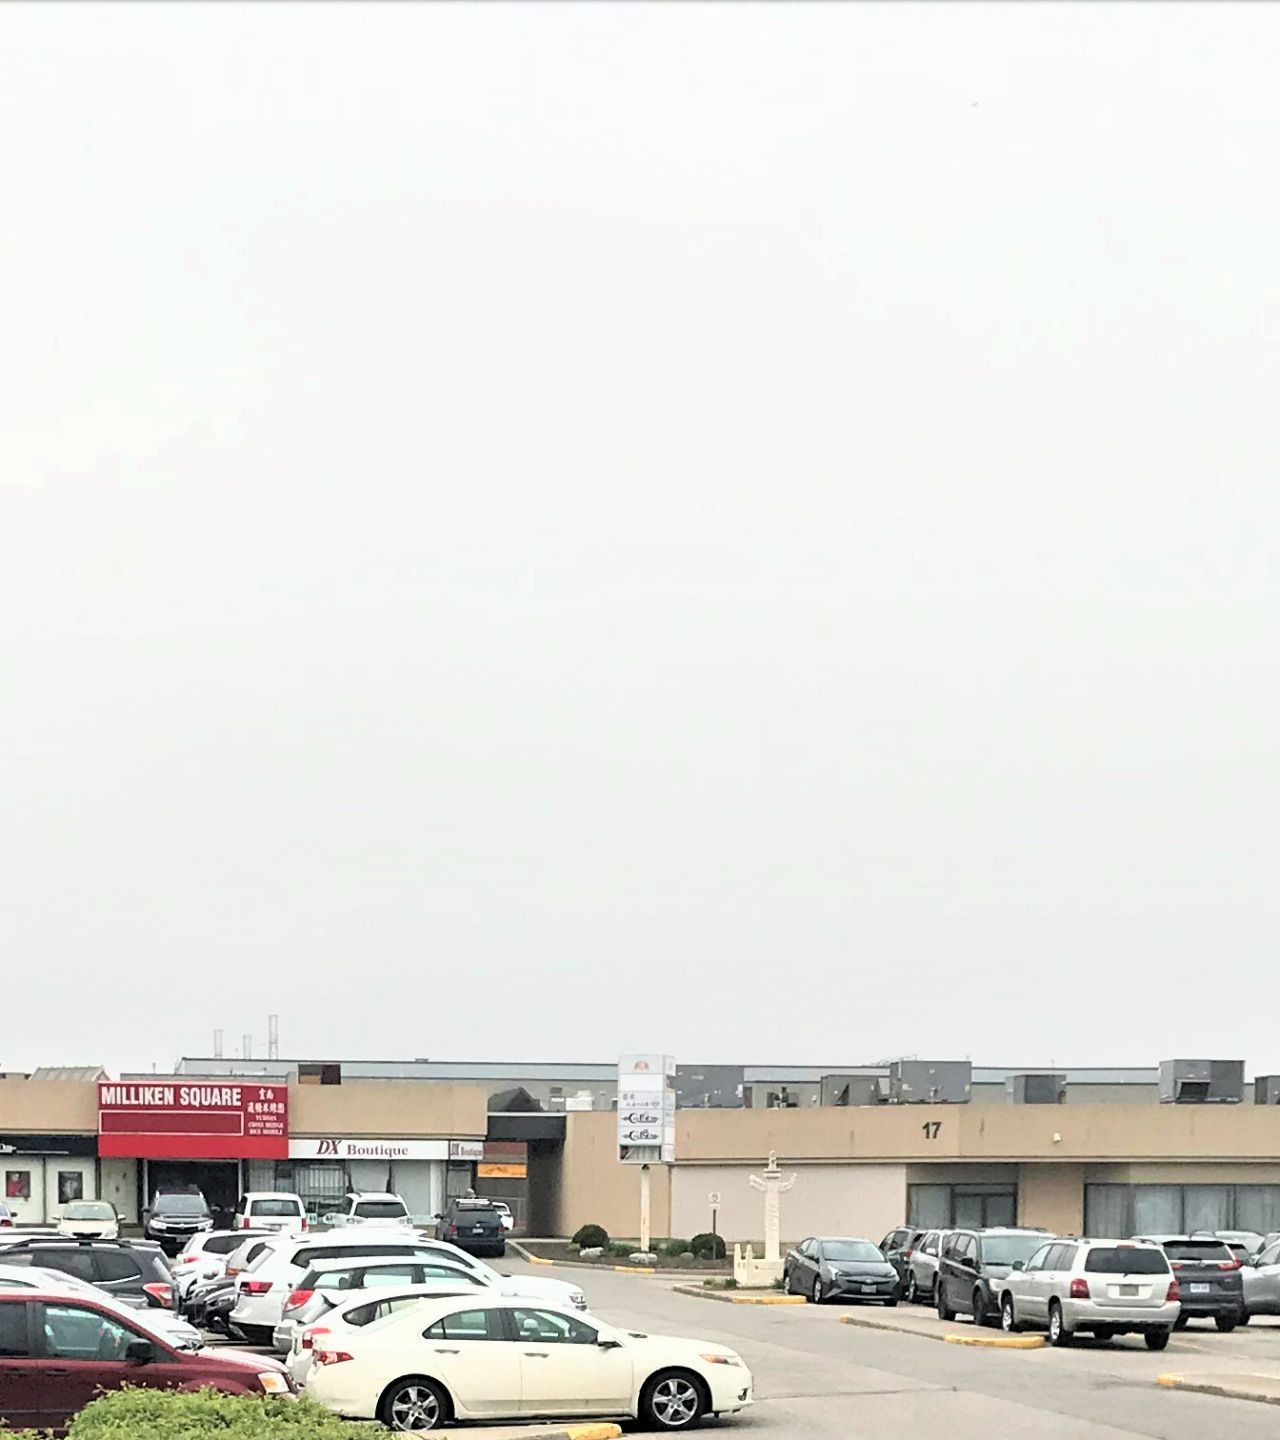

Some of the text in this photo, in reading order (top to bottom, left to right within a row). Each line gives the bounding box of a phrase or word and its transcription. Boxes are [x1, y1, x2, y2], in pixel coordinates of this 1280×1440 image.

[101, 1086, 242, 1107] MILLIKEN SQUARE
[922, 1121, 942, 1139] 17
[316, 1140, 409, 1158] DX Boutique
